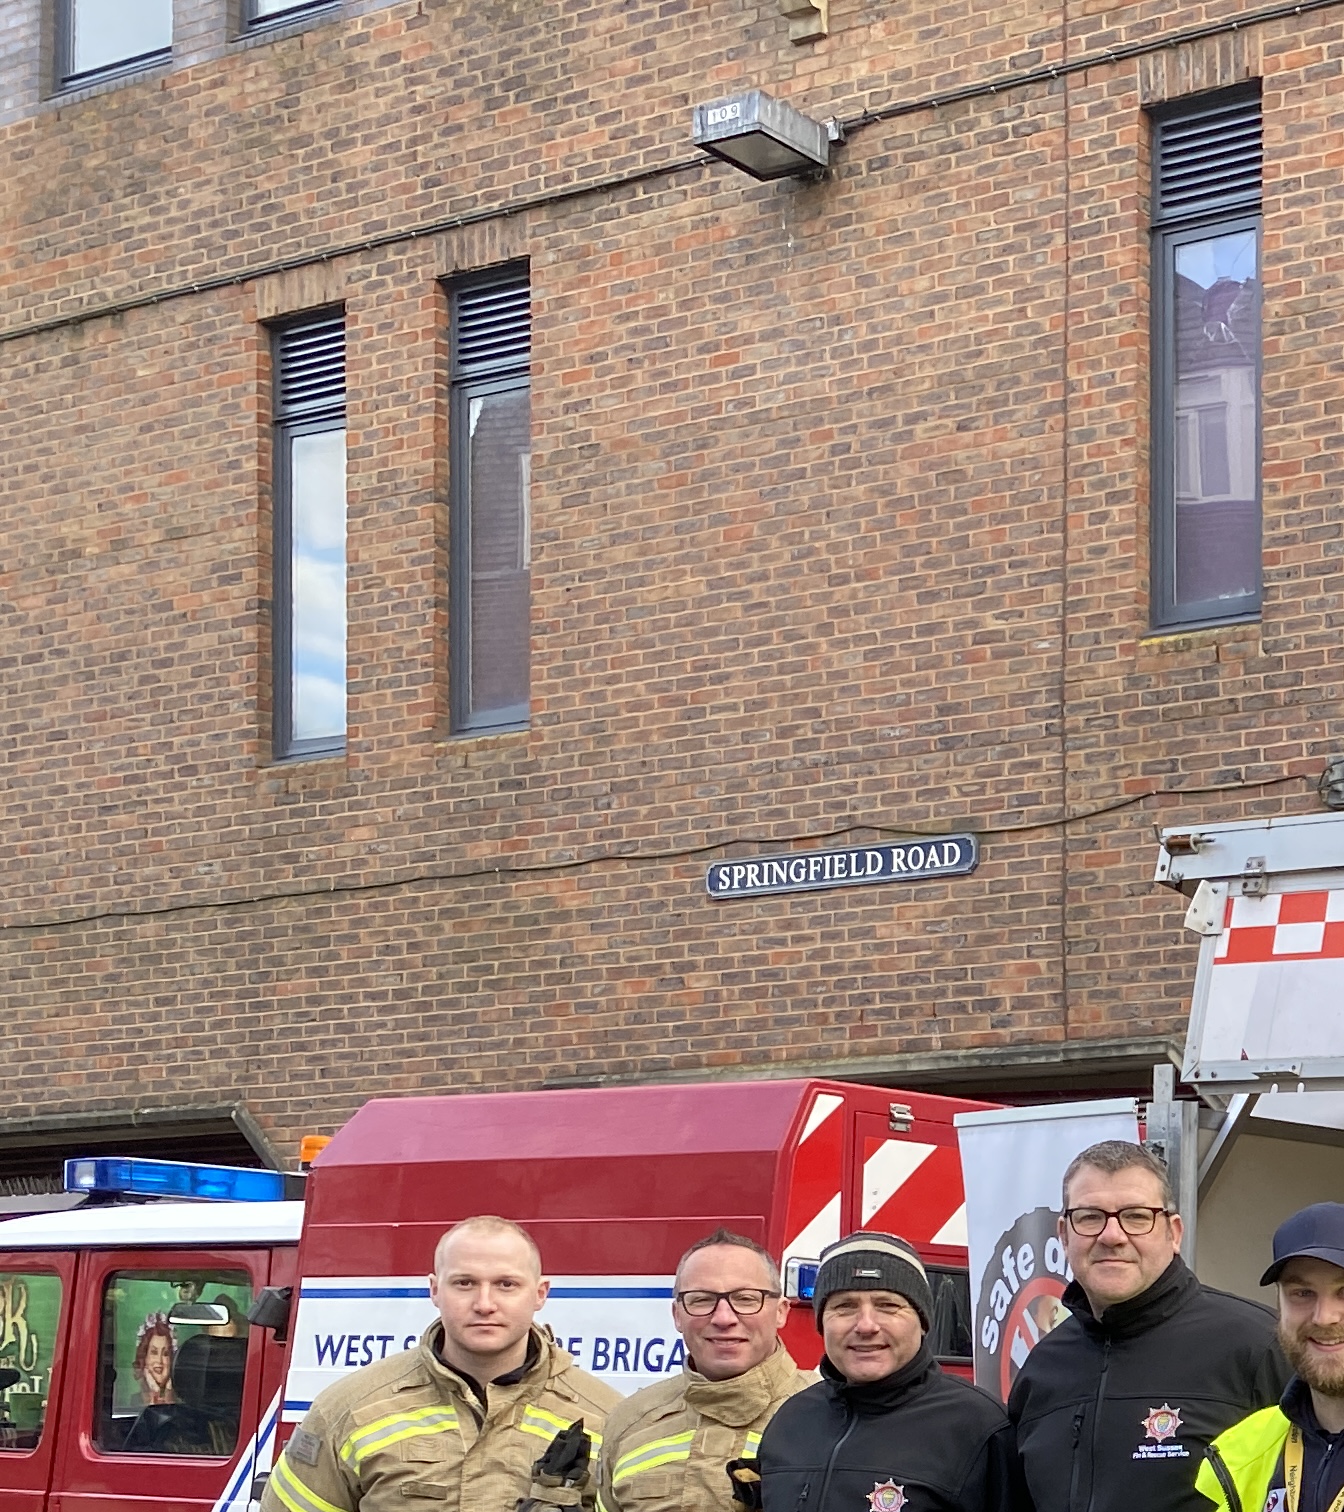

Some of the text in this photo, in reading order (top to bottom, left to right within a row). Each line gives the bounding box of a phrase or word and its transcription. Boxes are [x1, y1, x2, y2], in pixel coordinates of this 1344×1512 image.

[718, 842, 961, 890] SPRINGFIELD ROAD
[982, 1243, 1035, 1355] safe
[315, 1334, 395, 1367] WEST
